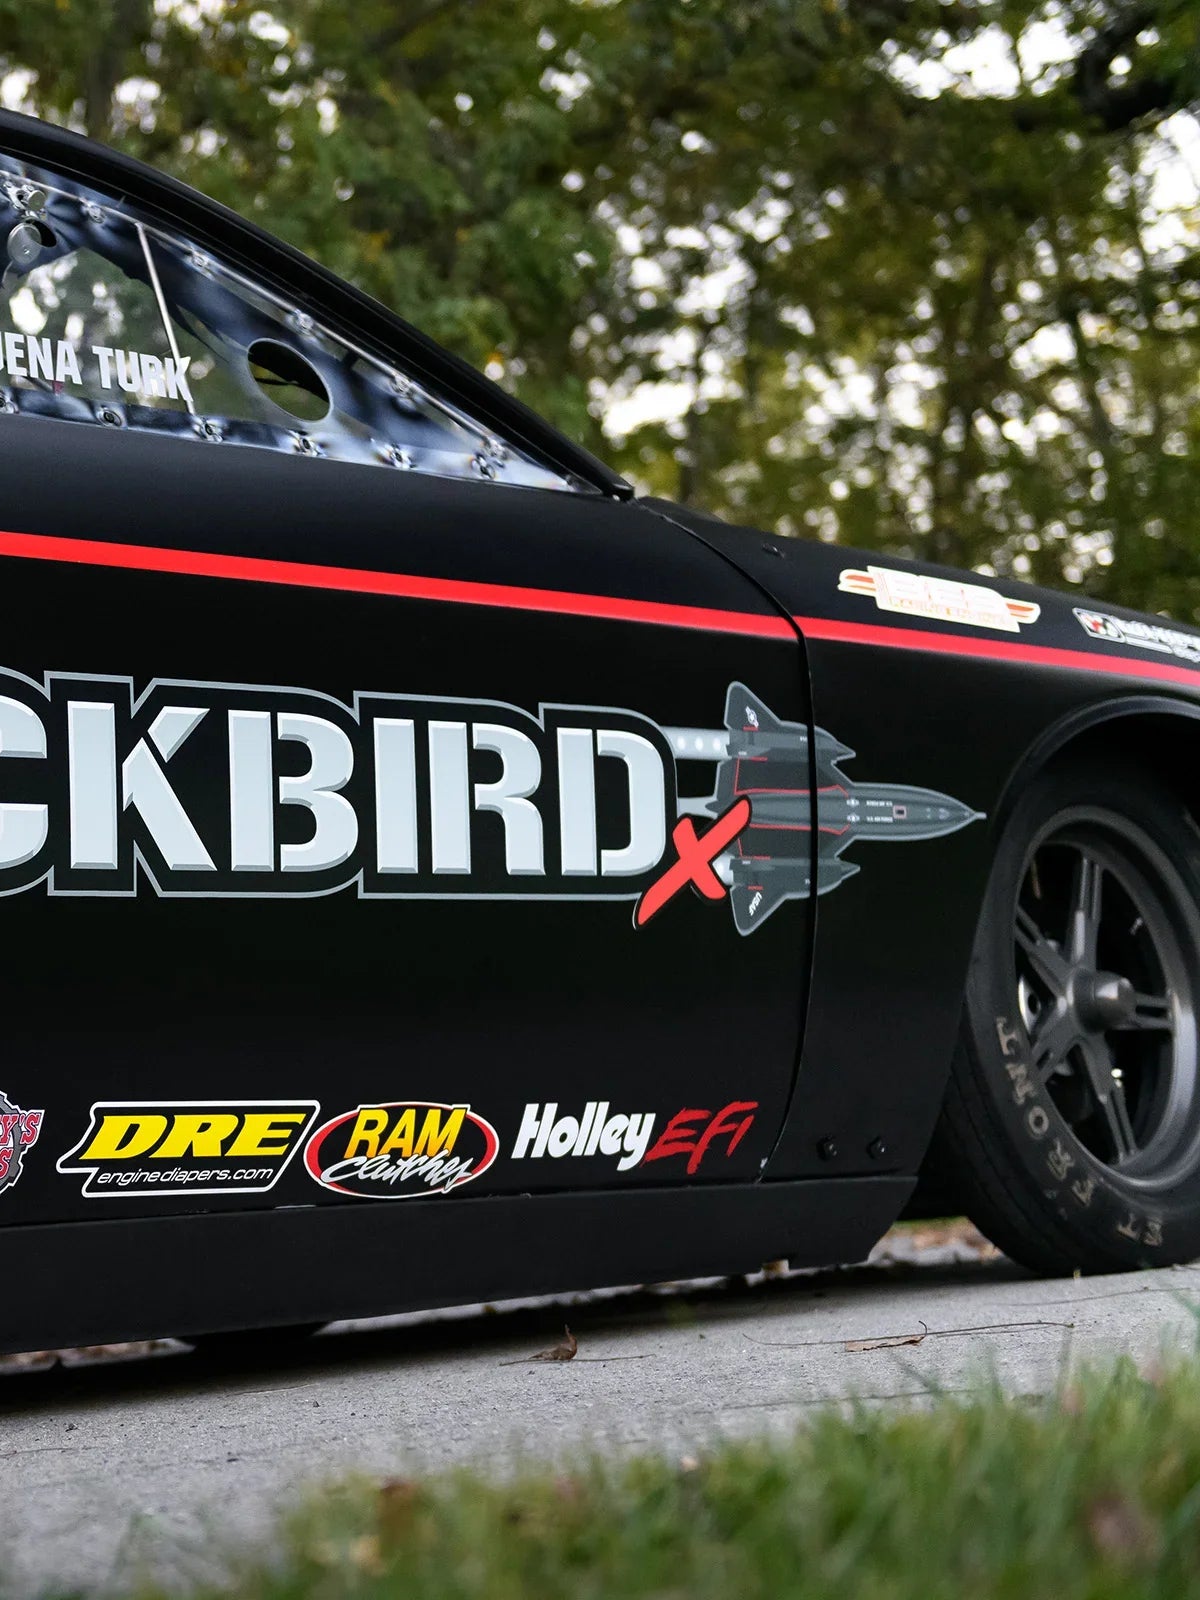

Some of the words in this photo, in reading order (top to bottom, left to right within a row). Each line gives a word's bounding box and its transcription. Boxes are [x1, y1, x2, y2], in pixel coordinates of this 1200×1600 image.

[92, 344, 194, 401] TURK
[78, 1113, 307, 1160] DRE
[343, 1106, 467, 1159] RAM
[511, 1101, 656, 1171] Holley
[97, 1166, 274, 1186] enginediapers.com
